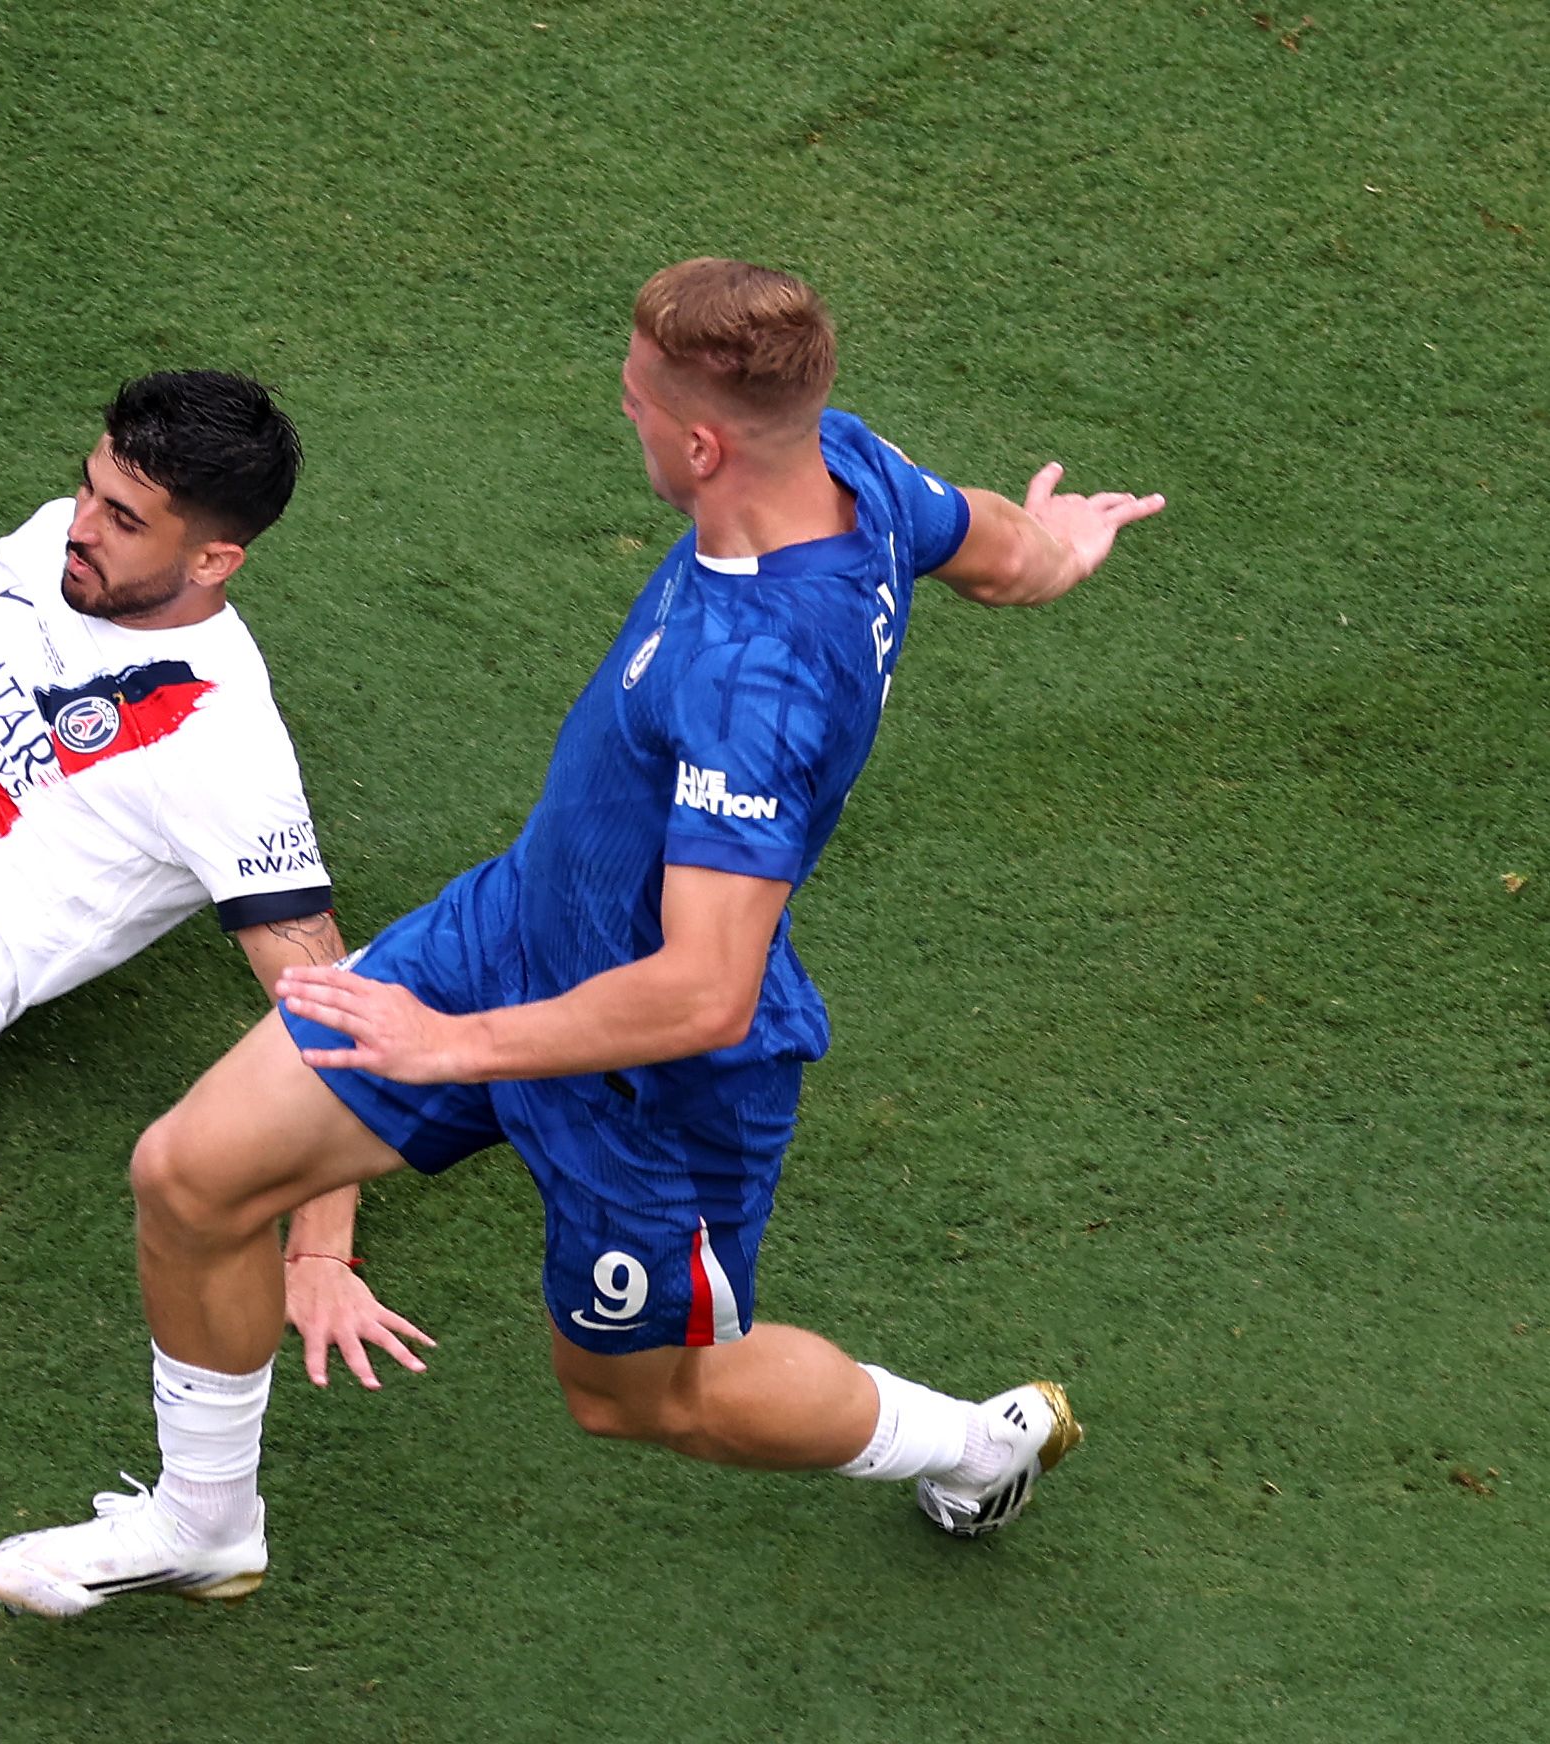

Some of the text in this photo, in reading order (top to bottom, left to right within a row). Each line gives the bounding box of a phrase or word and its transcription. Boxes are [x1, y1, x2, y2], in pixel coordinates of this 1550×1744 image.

[677, 760, 726, 794] LIVE
[674, 782, 778, 819] NATION
[258, 821, 314, 853] VISIT
[593, 1250, 648, 1320] 9
